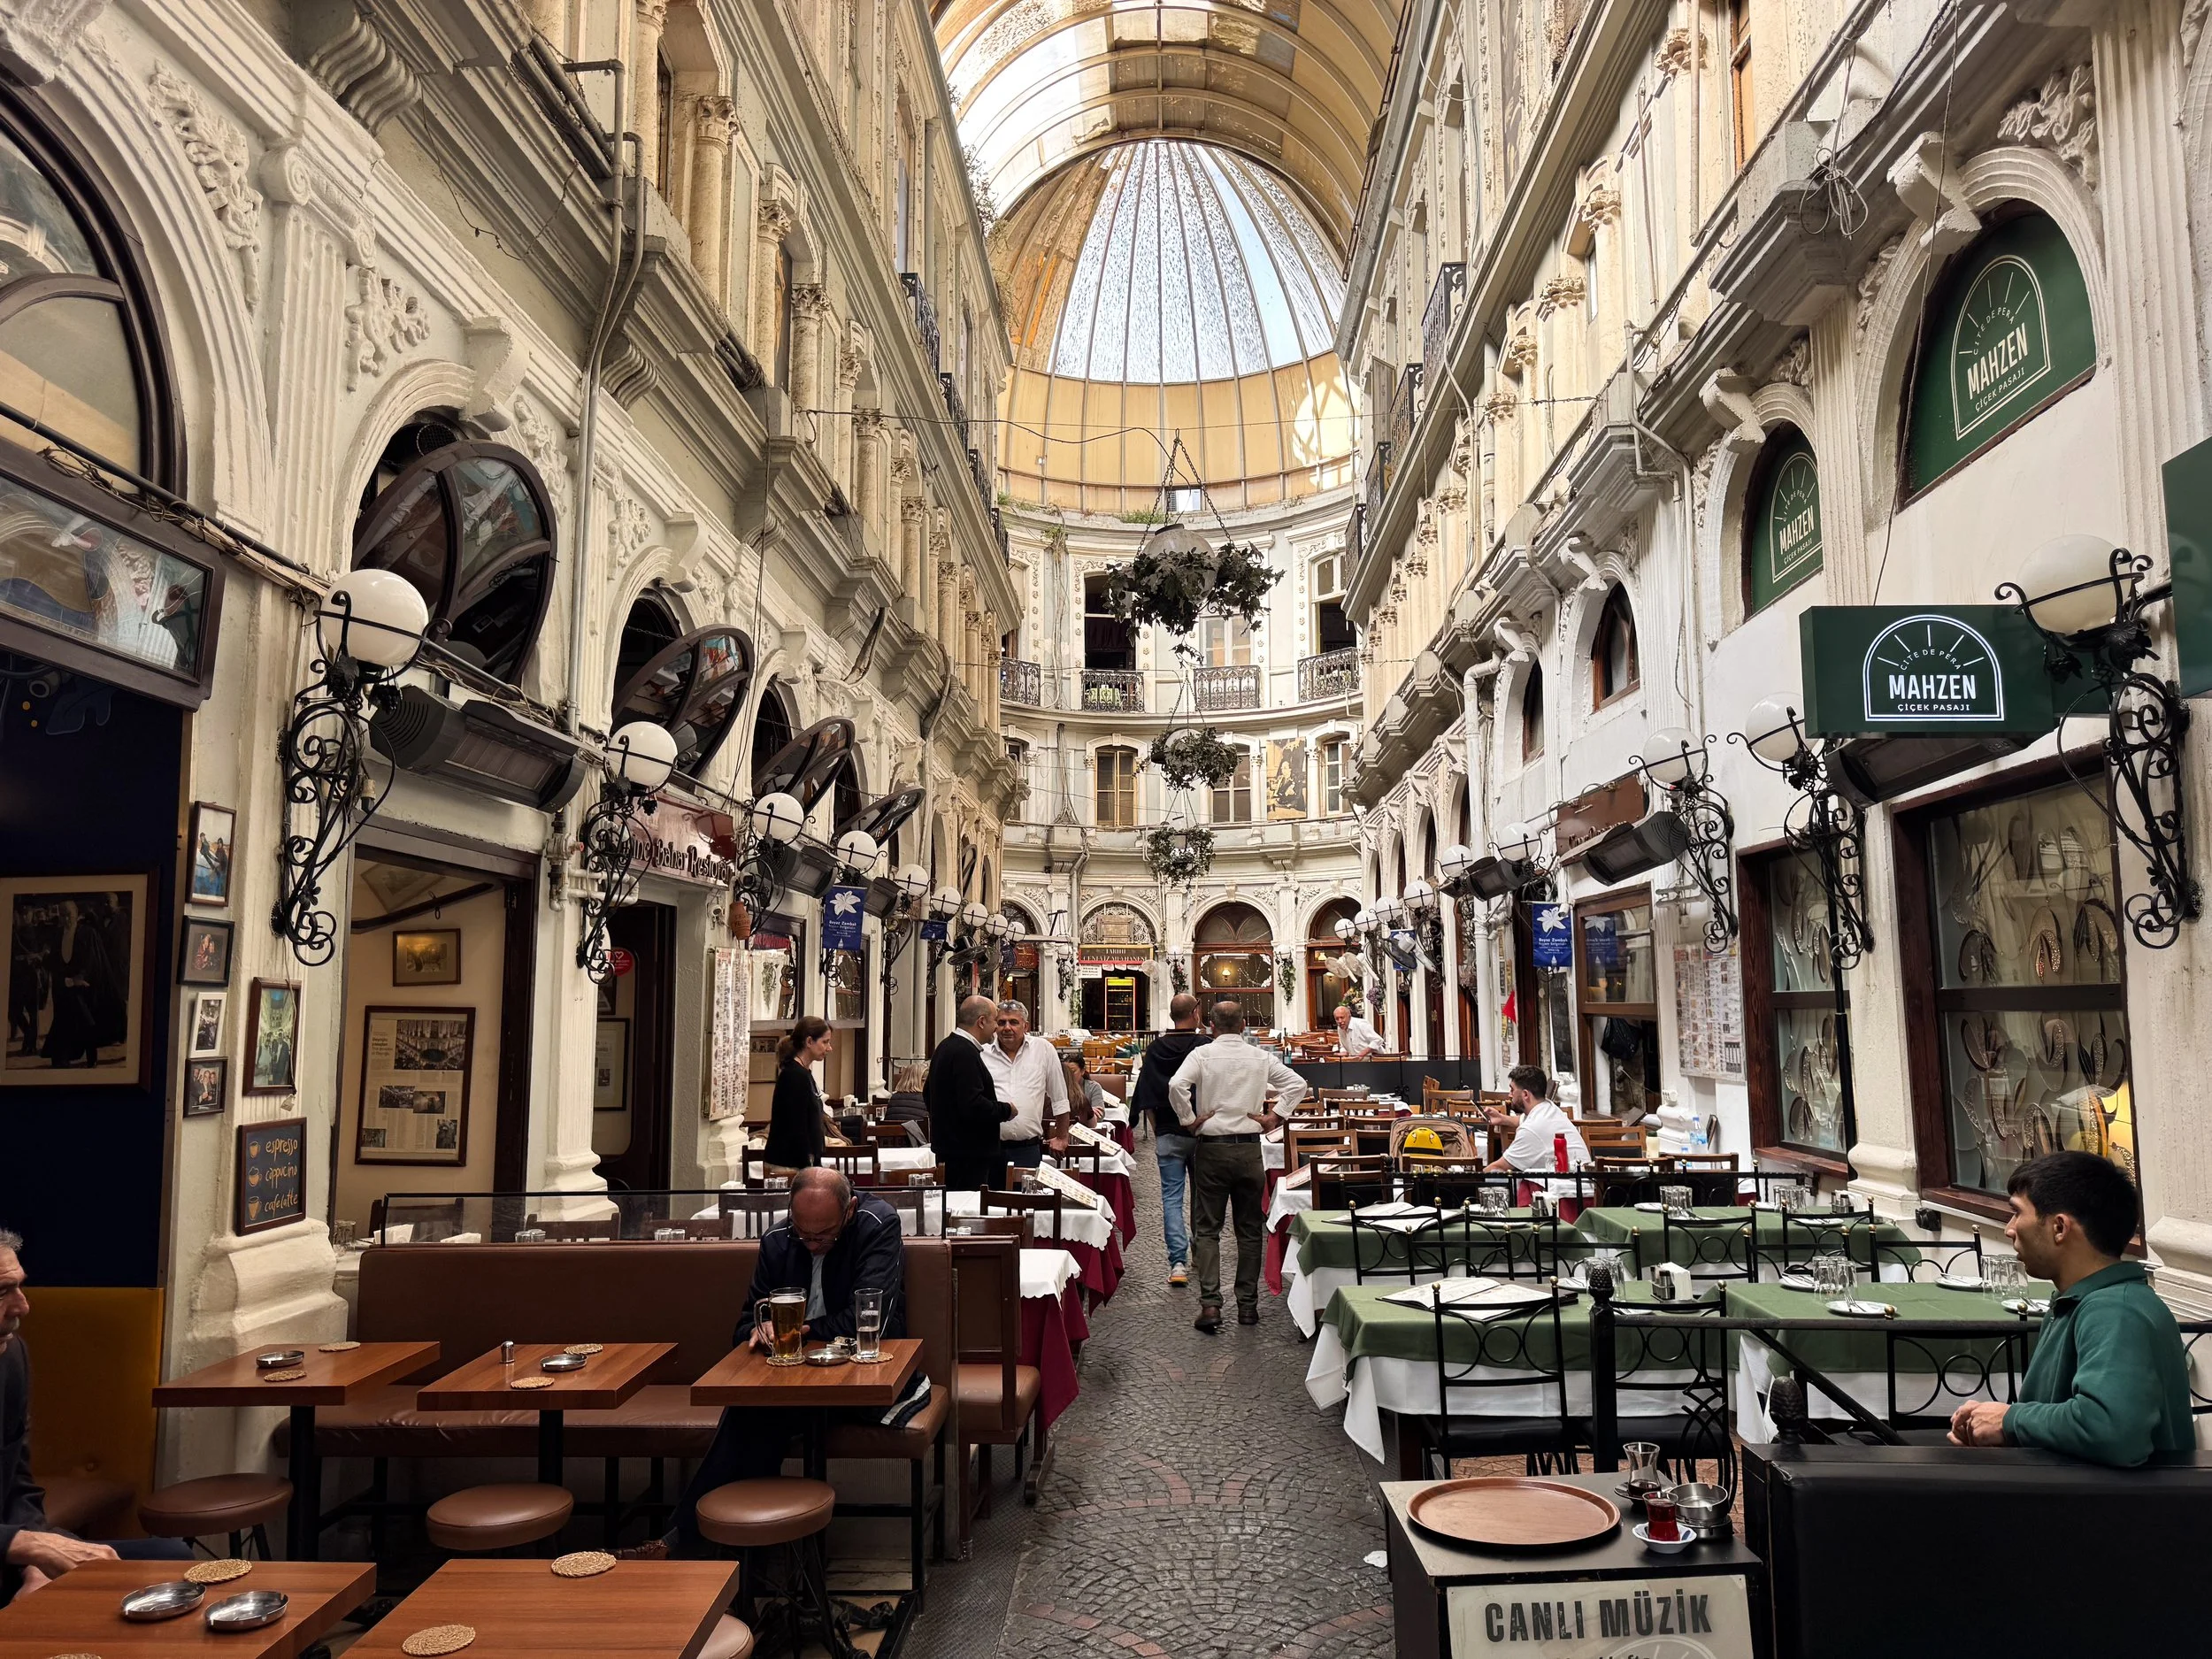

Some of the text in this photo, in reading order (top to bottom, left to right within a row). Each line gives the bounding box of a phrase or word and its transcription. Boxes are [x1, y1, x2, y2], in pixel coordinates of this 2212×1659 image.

[1973, 307, 2015, 356] CITE DE PERA
[1967, 322, 2028, 401] MAHZEN
[1975, 366, 2025, 413] ÇİÇEK PASAJI
[1779, 504, 1815, 555] MAHZEN
[1901, 651, 1920, 671] CITE
[1939, 650, 1961, 670] PERA
[1888, 674, 1977, 700] MAHZEN
[1898, 703, 1930, 712] ÇİÇEK
[265, 1138, 298, 1162] espresso
[1485, 1588, 1712, 1643] CANLI MÜZİK
